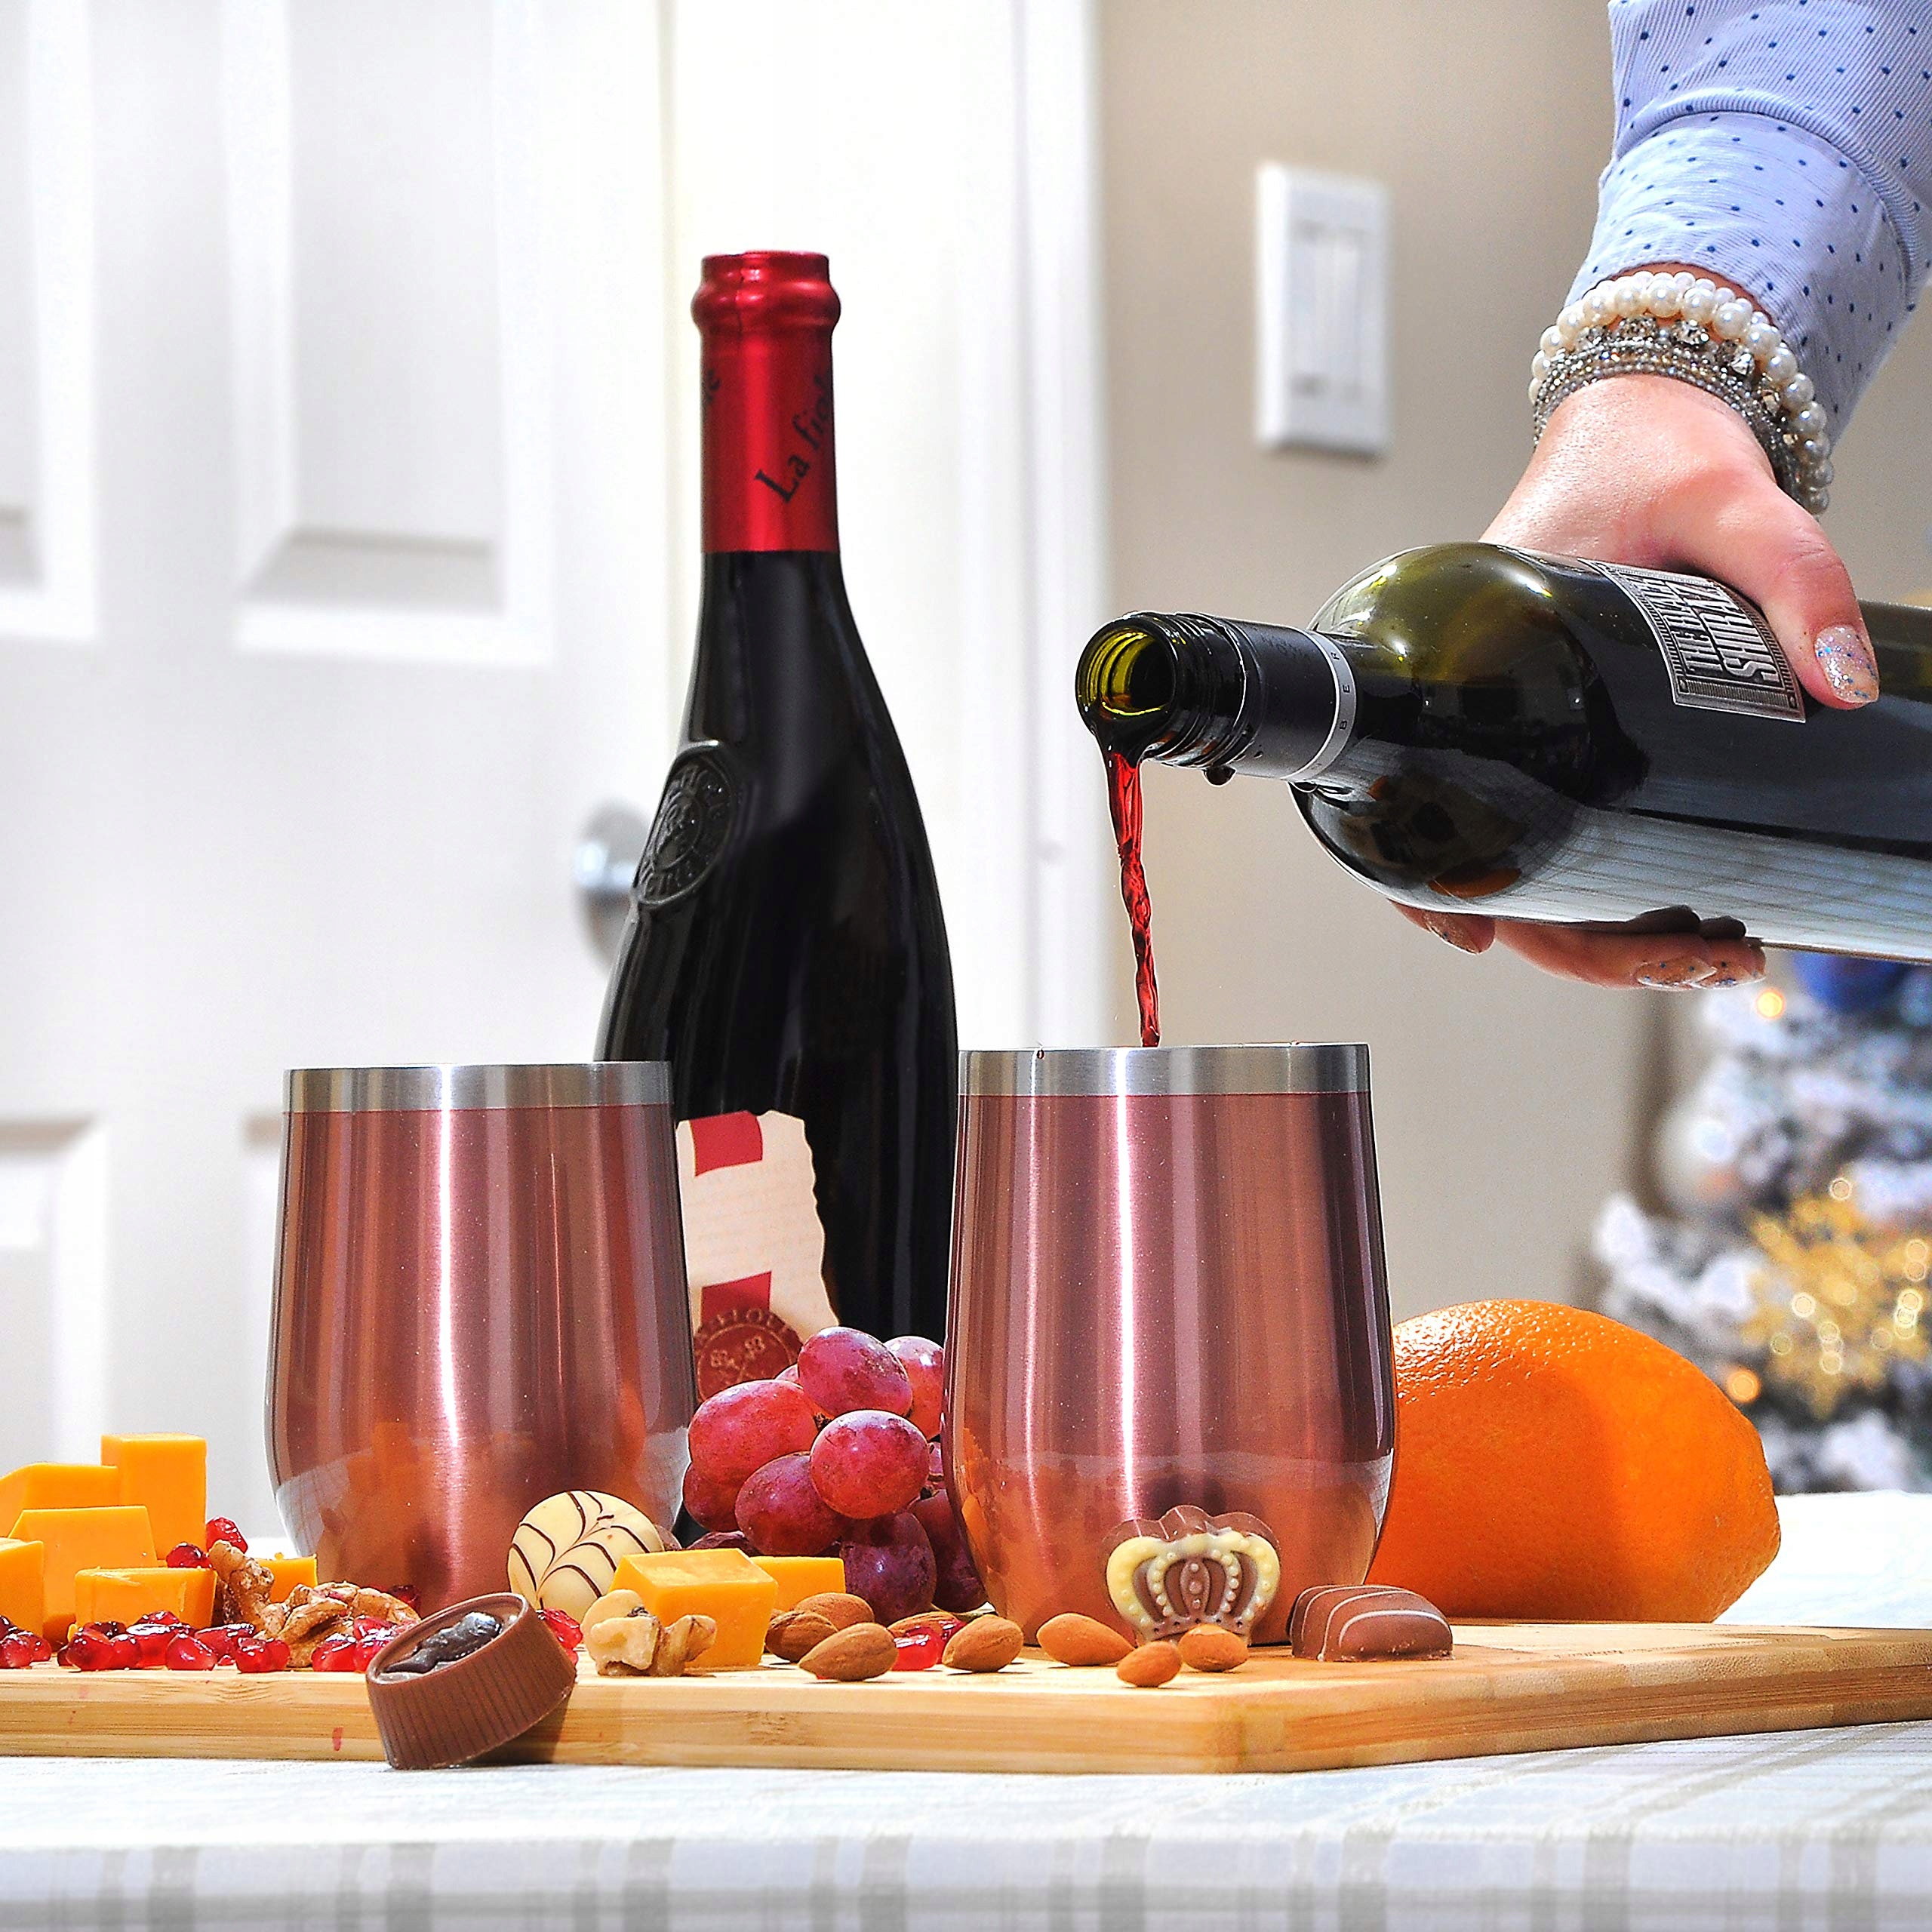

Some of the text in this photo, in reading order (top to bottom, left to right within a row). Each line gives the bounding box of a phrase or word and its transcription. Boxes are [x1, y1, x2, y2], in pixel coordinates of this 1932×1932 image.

[755, 454, 811, 503] La
[1619, 574, 1724, 672] THE BLACK
[1665, 580, 1780, 682] SHIRAZ
